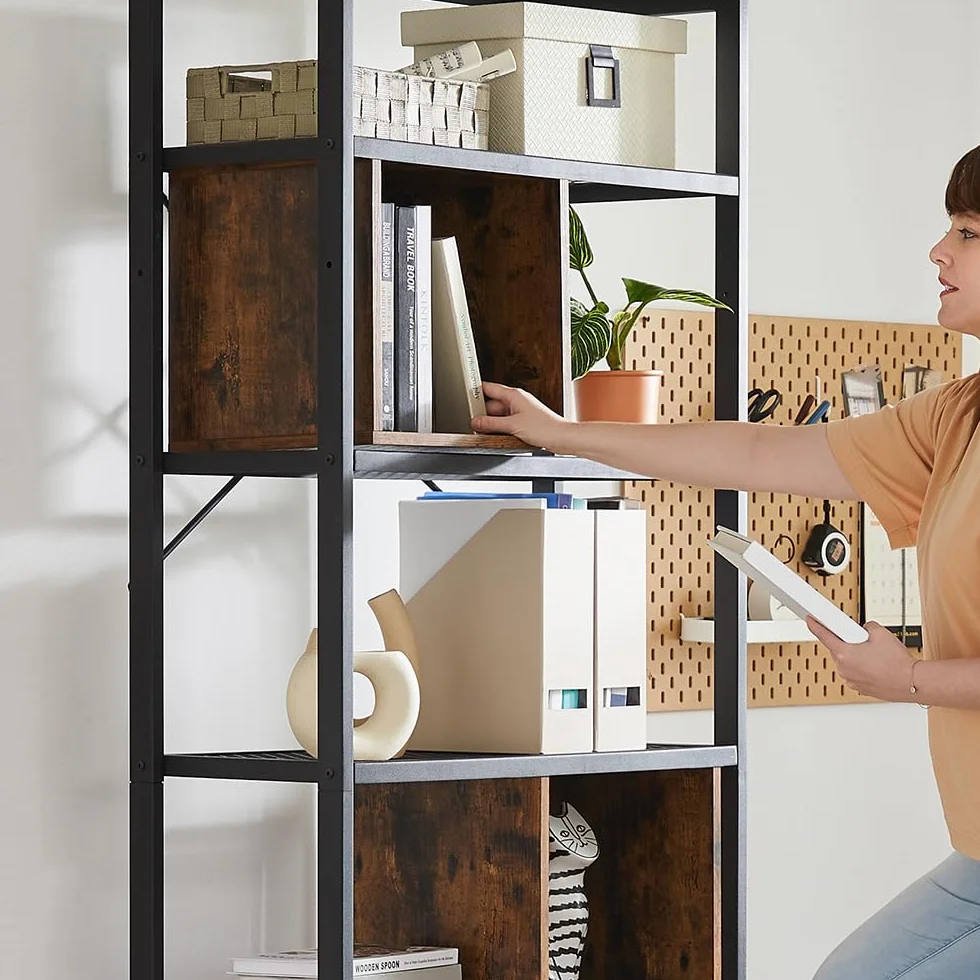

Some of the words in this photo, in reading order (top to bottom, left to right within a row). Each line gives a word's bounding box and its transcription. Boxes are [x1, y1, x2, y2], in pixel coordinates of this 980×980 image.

[382, 221, 391, 250] BUILDING
[407, 227, 415, 262] TRAVEL
[382, 256, 391, 278] BRAND
[407, 264, 415, 292] BOOK
[420, 290, 428, 351] KINFOLK
[355, 963, 380, 973] WOODEN
[381, 960, 400, 970] SPOON
